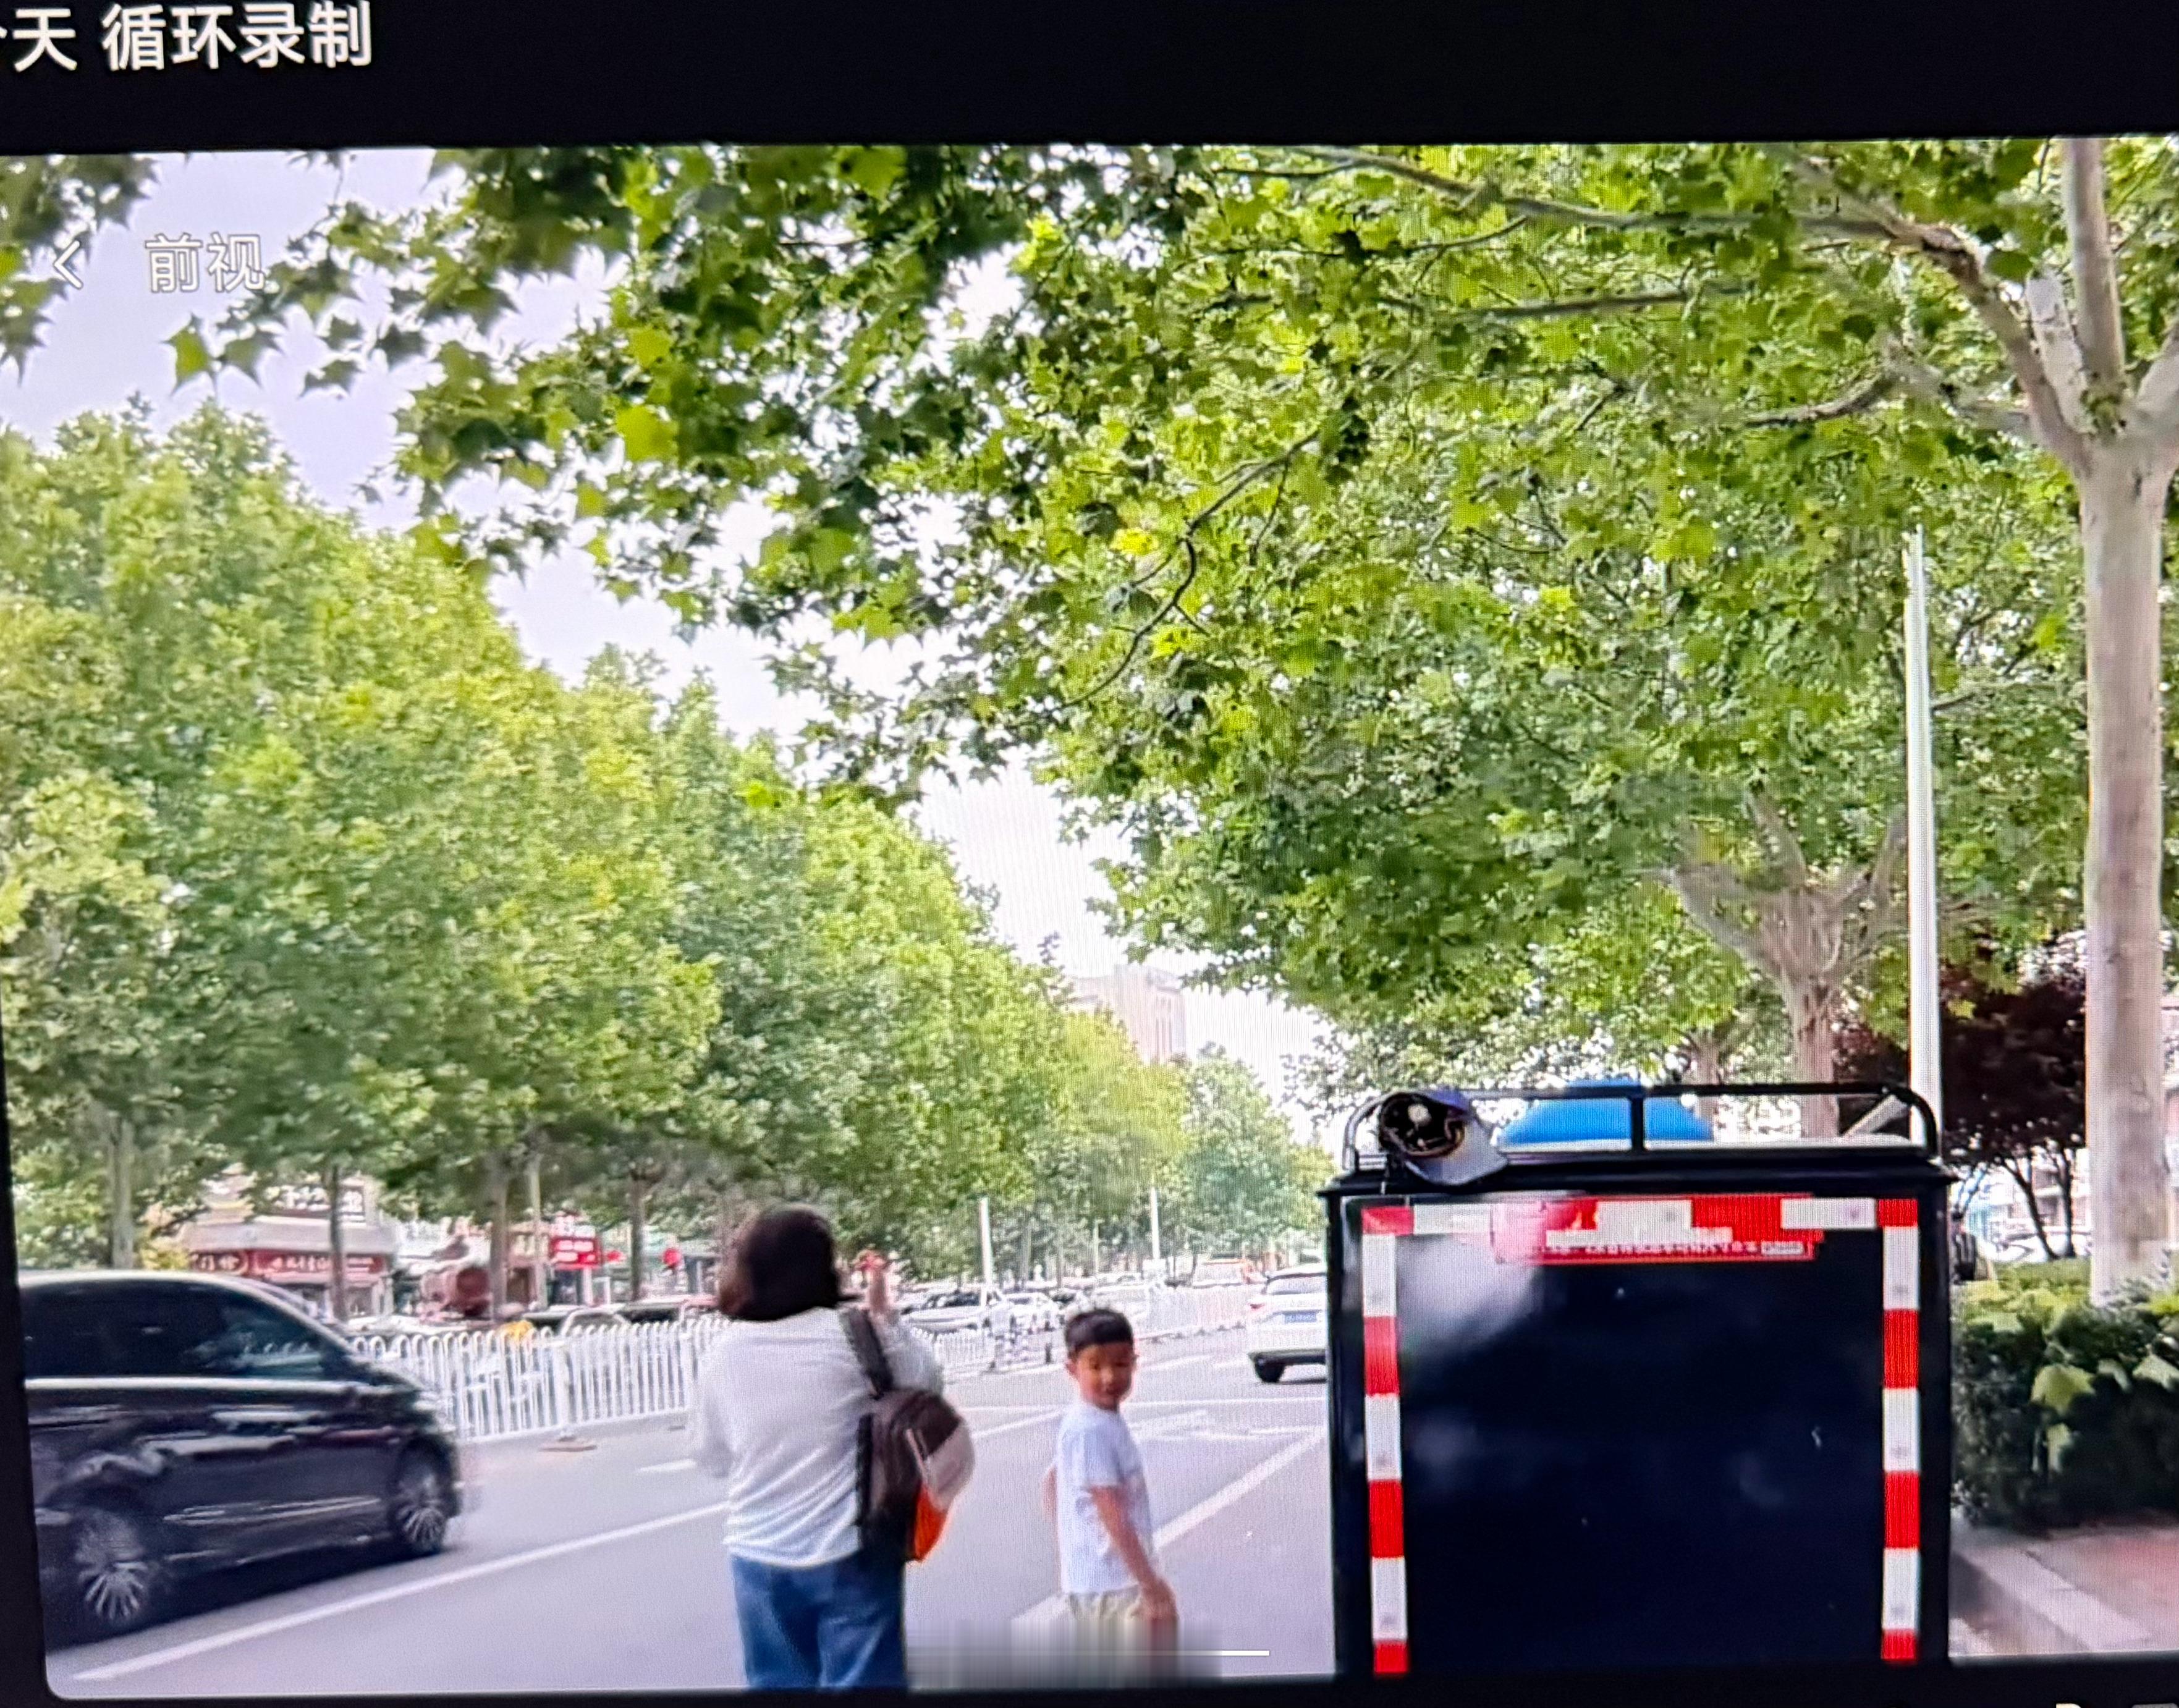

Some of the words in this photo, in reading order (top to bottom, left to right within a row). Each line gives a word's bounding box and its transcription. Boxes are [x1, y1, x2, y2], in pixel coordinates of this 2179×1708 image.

[0, 7, 77, 71] 天
[101, 0, 372, 71] 循环录制
[145, 232, 266, 294] 前视
